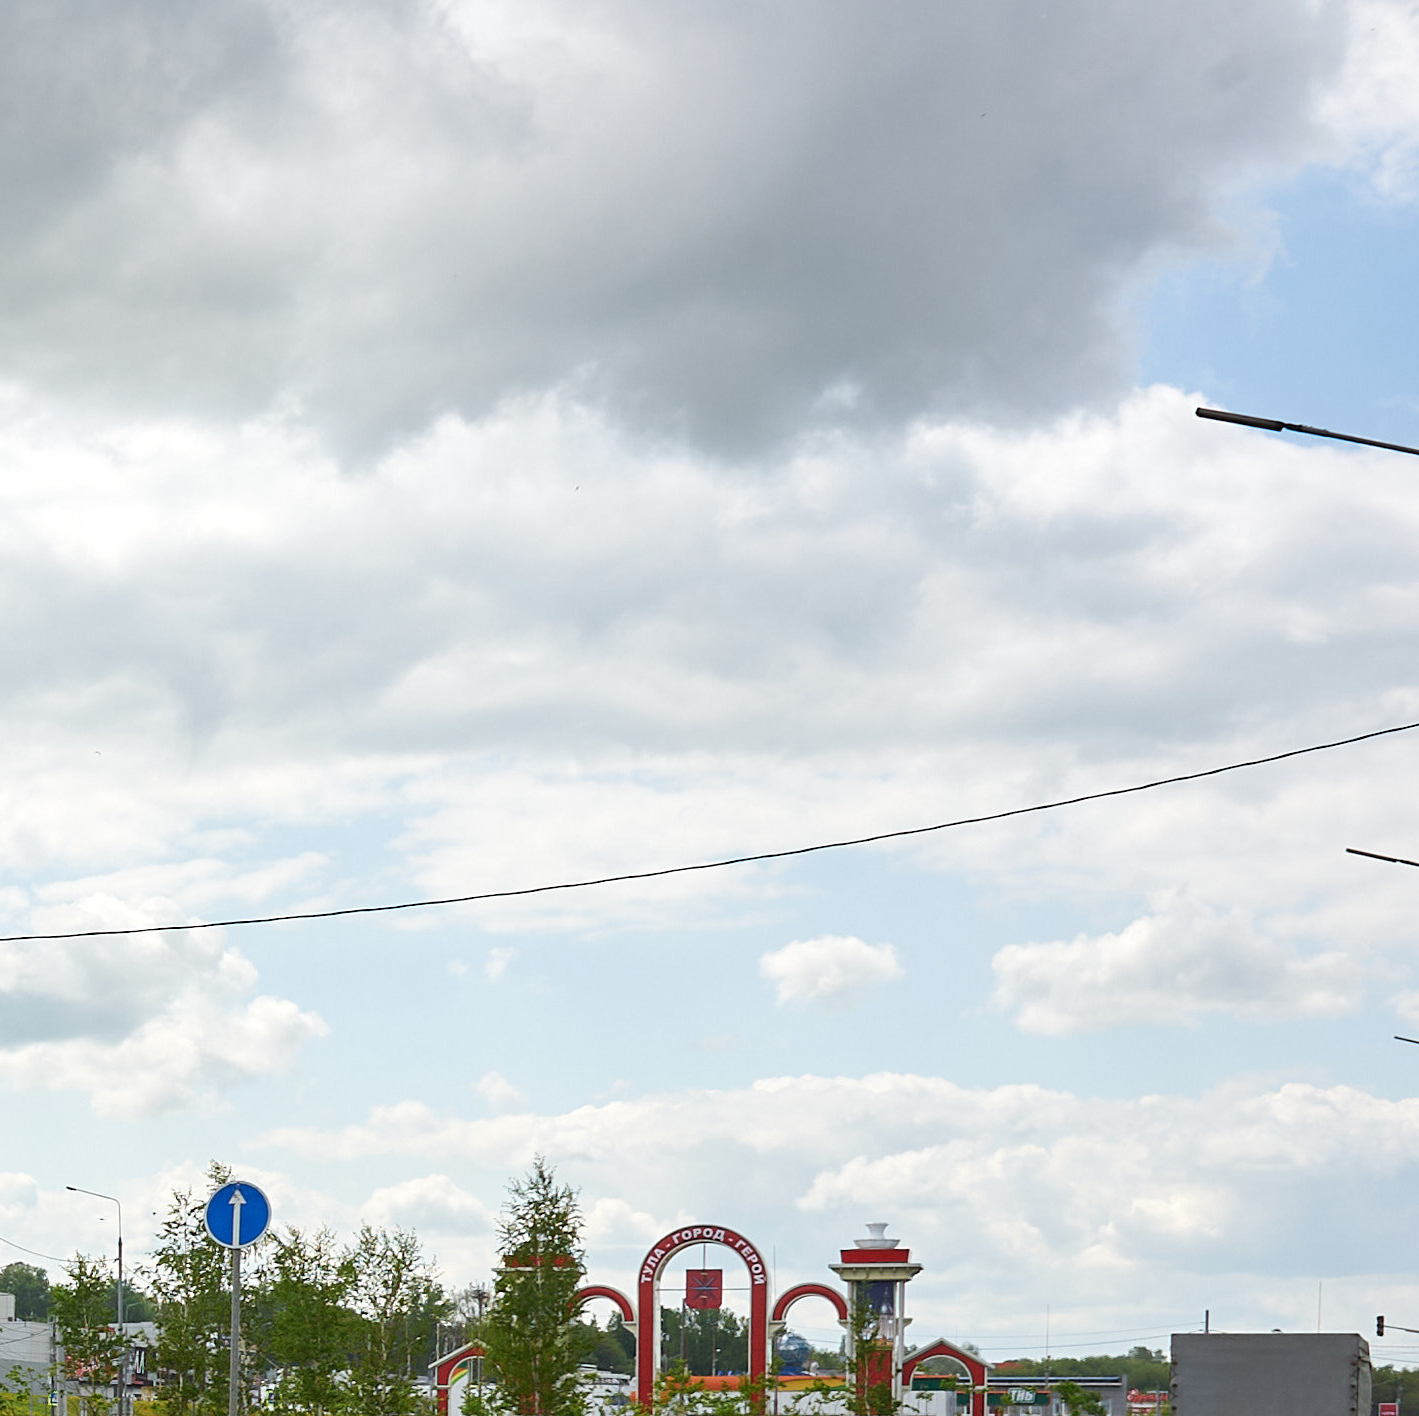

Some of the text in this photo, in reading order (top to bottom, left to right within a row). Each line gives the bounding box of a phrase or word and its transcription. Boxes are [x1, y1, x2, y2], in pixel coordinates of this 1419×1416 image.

[641, 1249, 665, 1283] ТУЛА
[672, 1227, 725, 1244] ГОРОД
[734, 1240, 766, 1285] ГЕРОЙ
